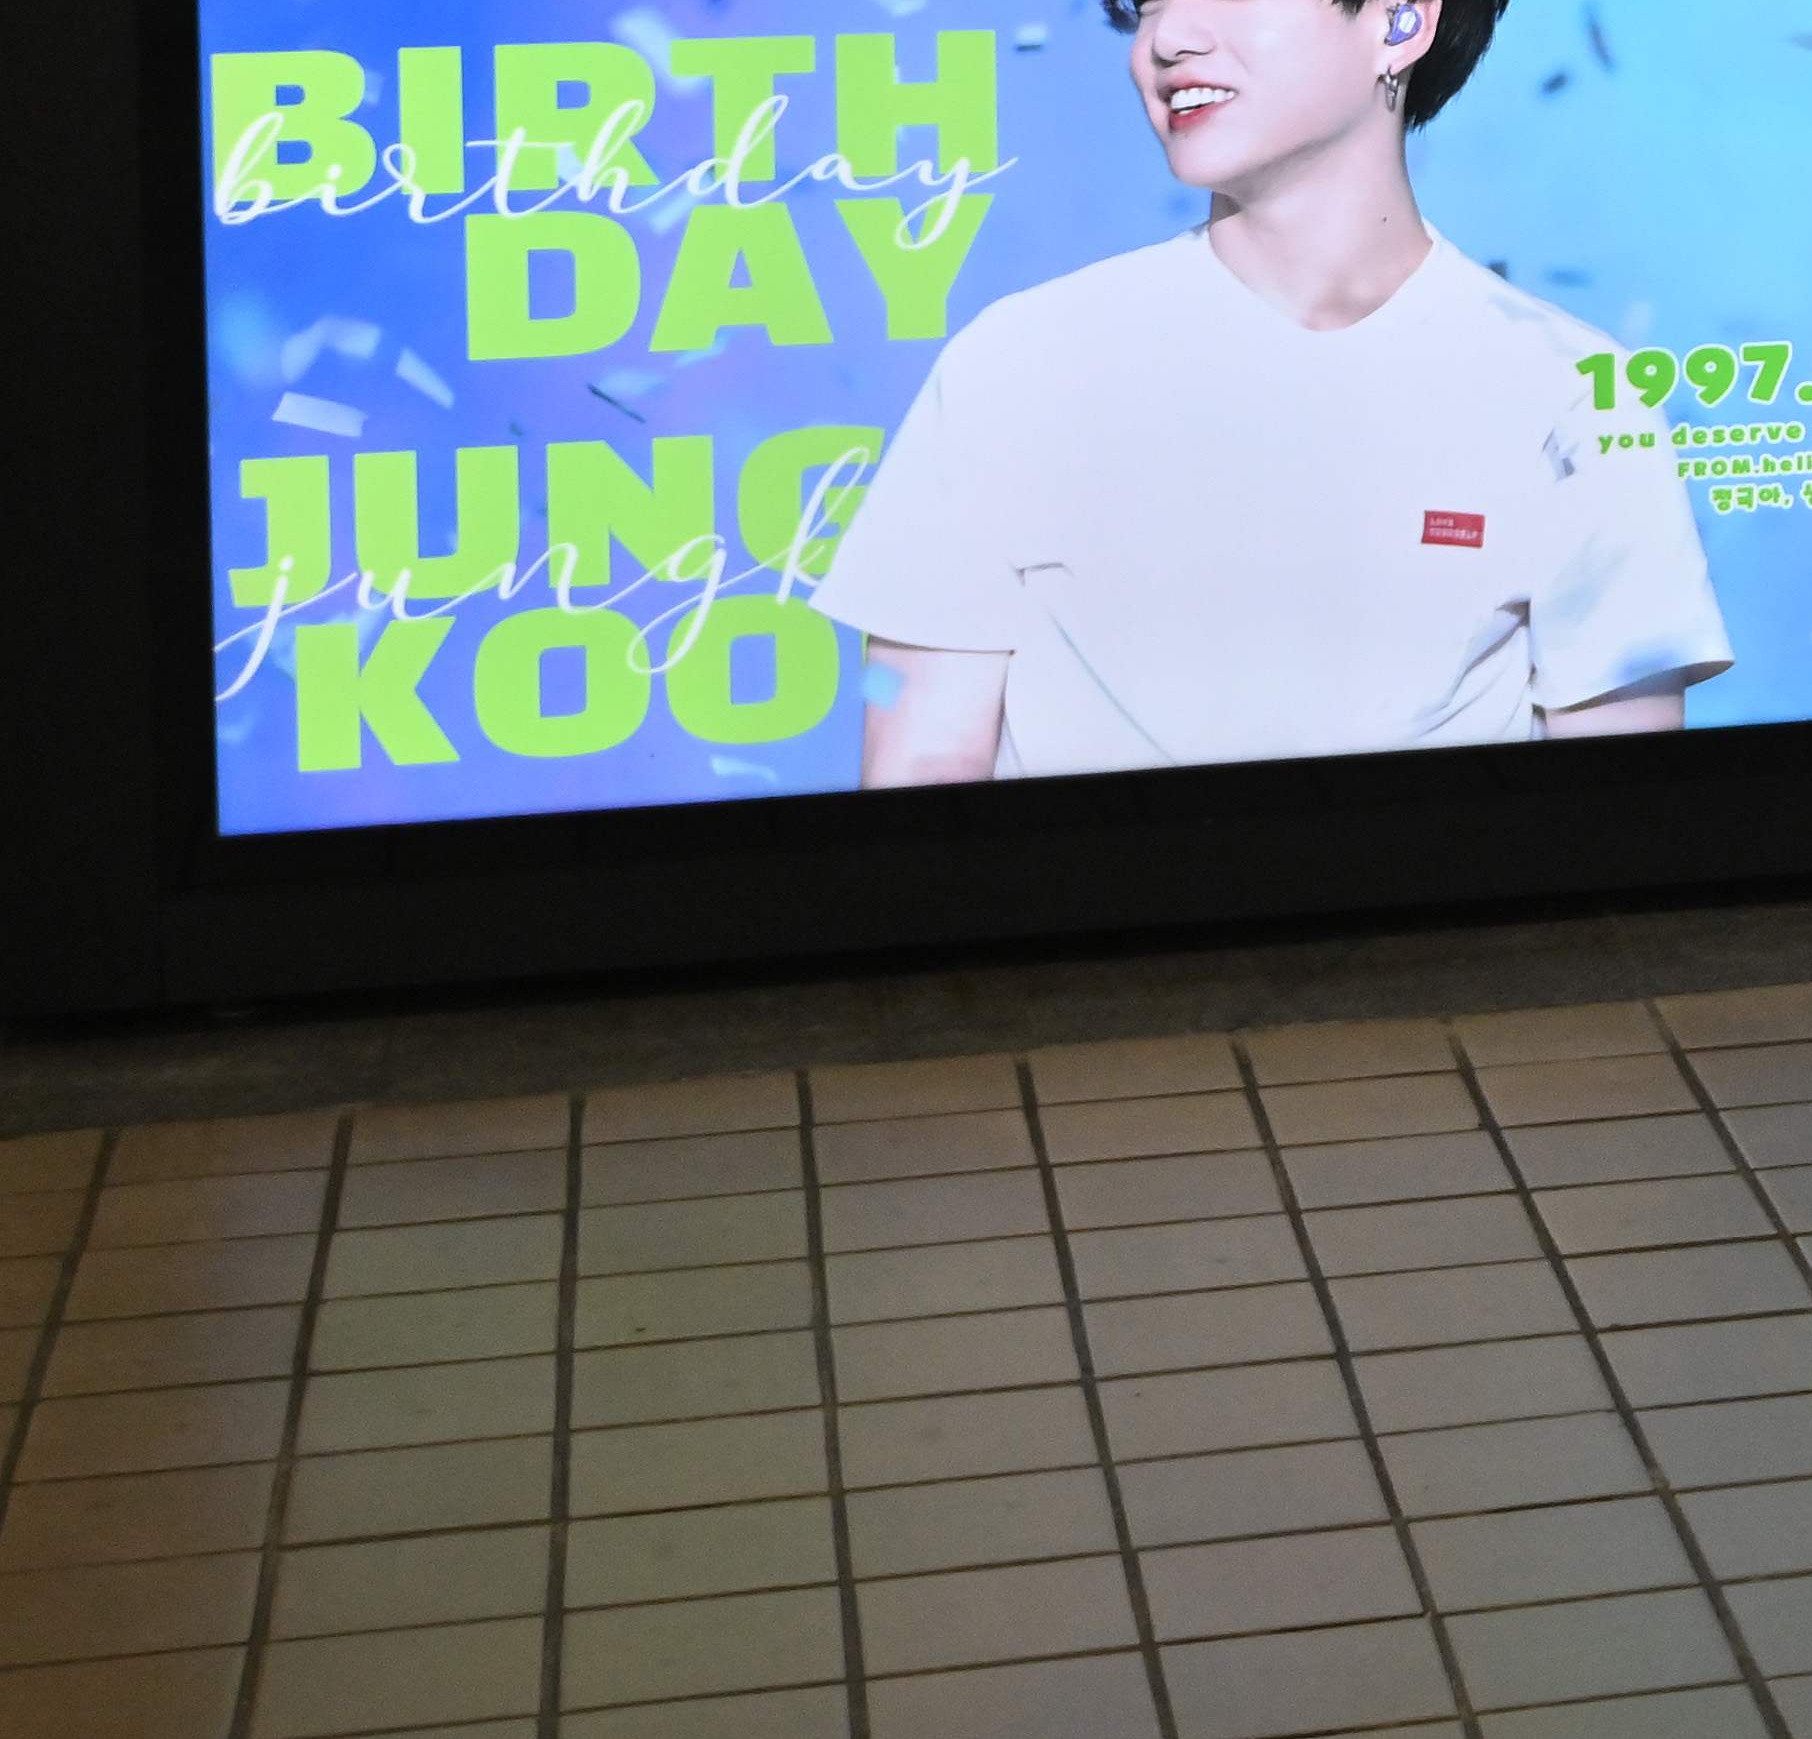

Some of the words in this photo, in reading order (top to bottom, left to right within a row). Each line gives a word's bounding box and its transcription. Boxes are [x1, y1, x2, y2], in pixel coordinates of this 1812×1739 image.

[212, 30, 998, 203] BIRTH
[214, 94, 1019, 250] birthday
[463, 193, 995, 361] DAY
[228, 425, 885, 608] JUNG
[1598, 427, 1656, 454] you
[1670, 421, 1805, 448] deserve
[214, 446, 870, 701] jungk
[295, 592, 840, 772] KOO
